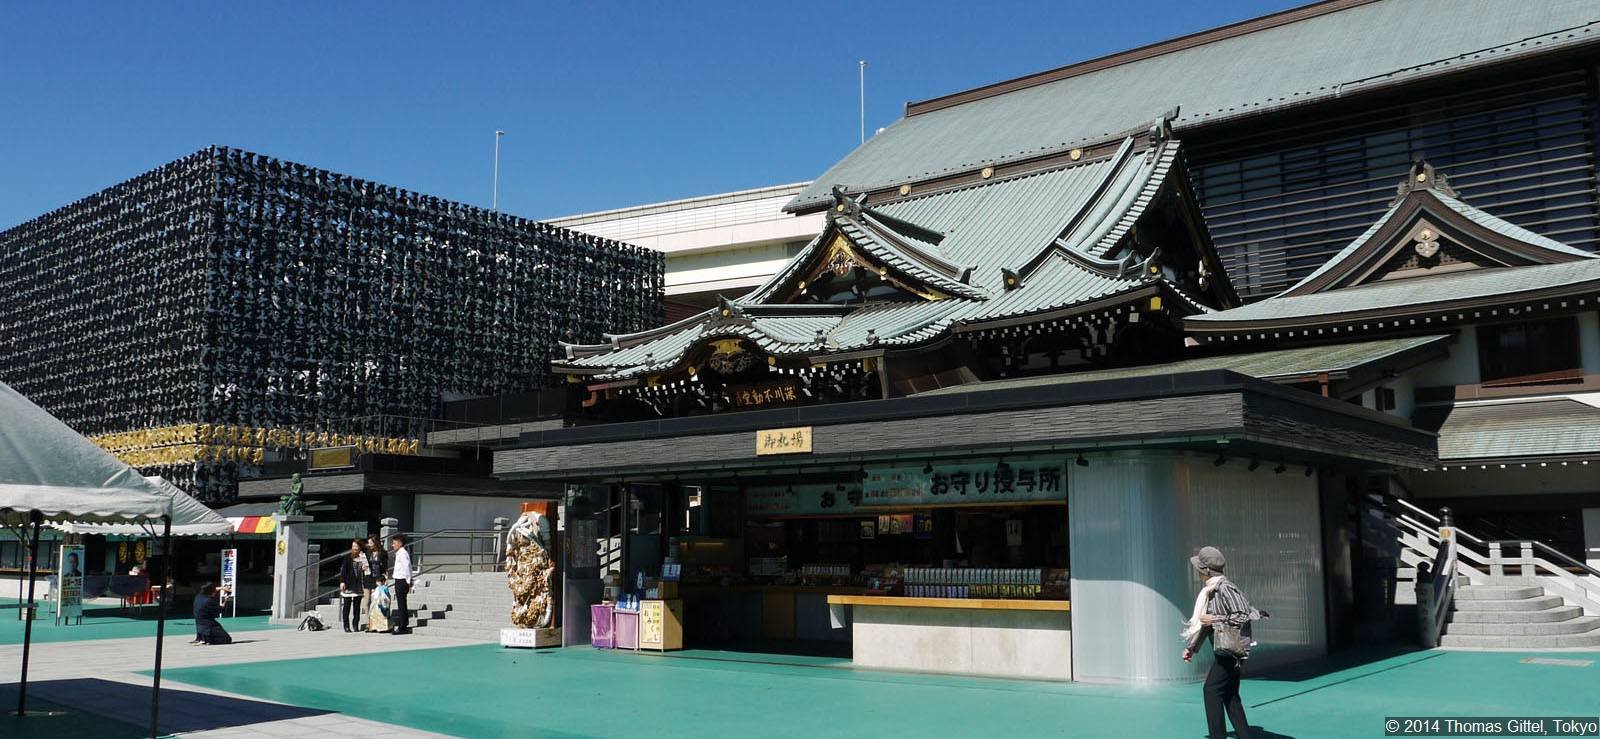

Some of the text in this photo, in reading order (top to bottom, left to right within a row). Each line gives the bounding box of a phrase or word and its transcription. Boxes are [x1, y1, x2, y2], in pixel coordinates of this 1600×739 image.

[930, 468, 1061, 495] お守り授与所
